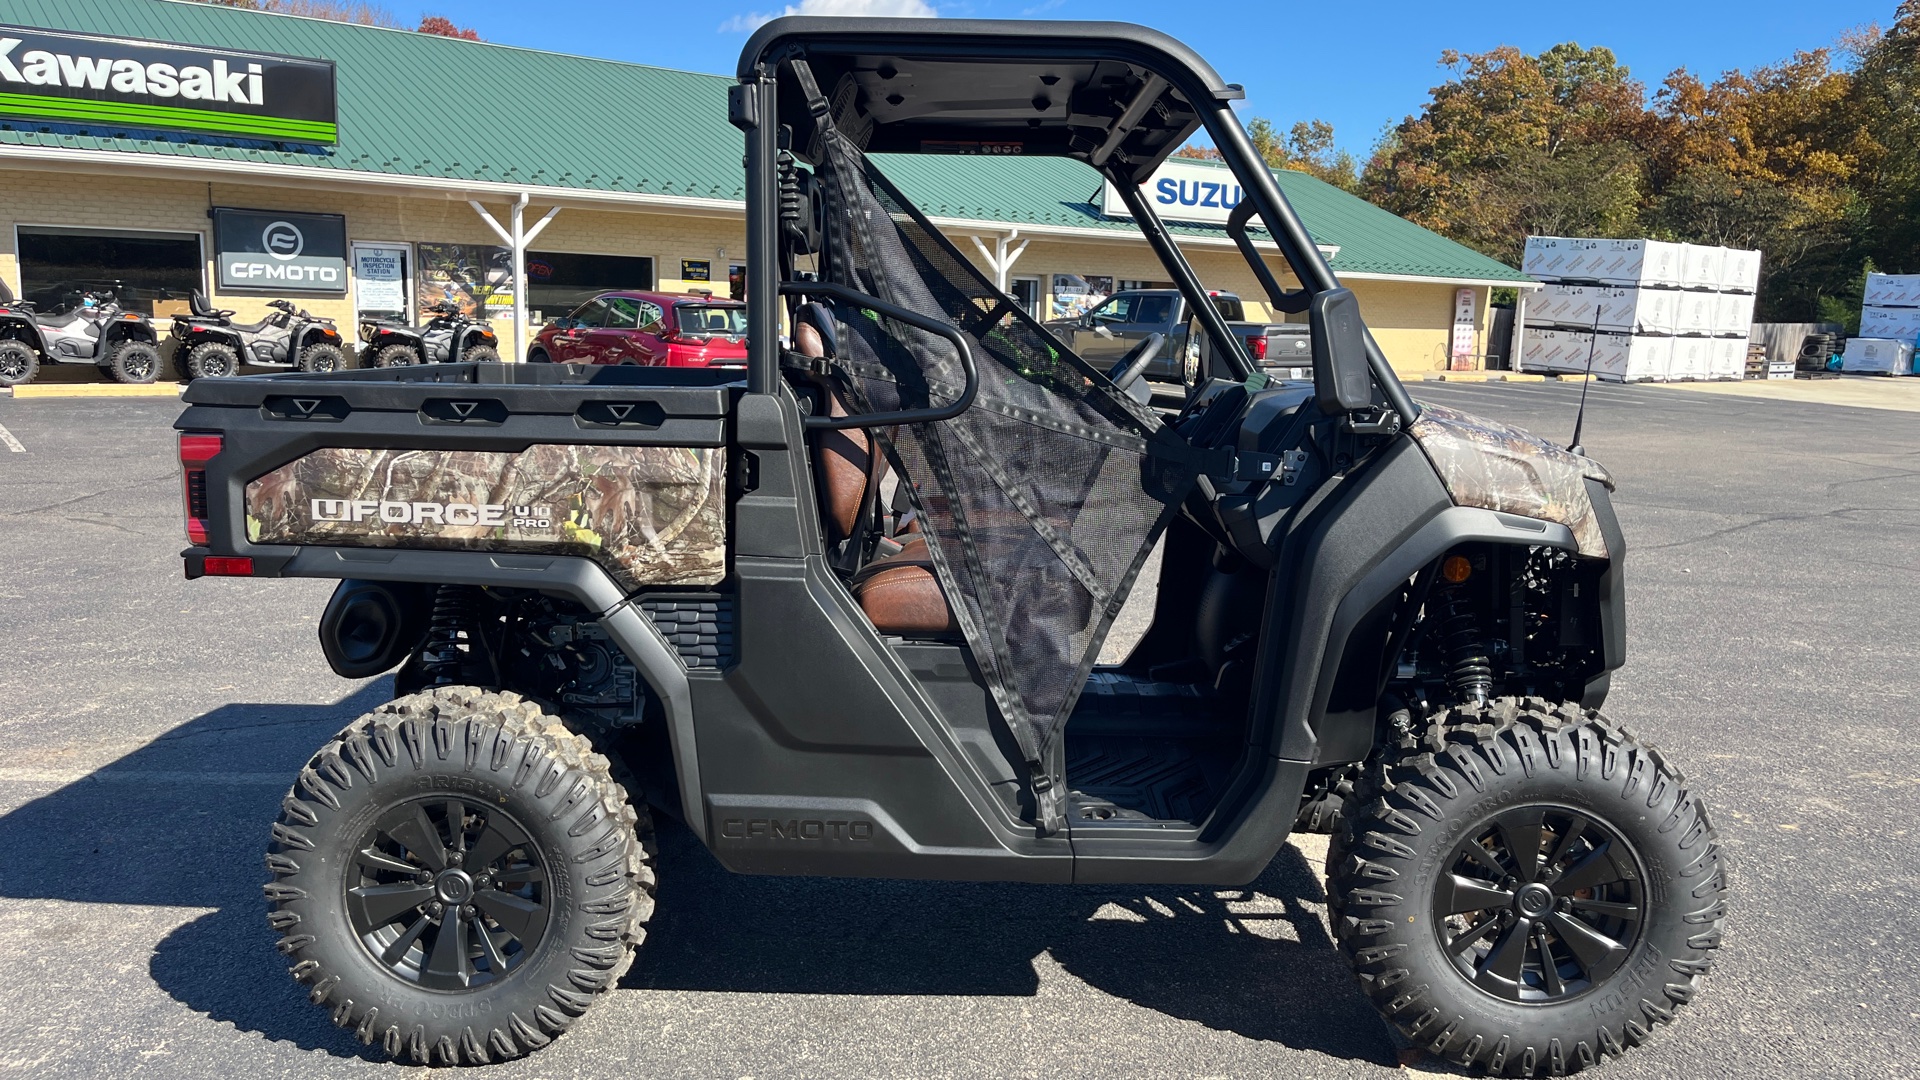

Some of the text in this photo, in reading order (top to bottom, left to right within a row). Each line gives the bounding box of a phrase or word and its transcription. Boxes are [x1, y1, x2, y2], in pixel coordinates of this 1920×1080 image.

[1156, 177, 1246, 209] SUZU
[230, 262, 340, 283] CFMOTO
[513, 518, 550, 528] PRO
[721, 818, 874, 841] CFMOTO
